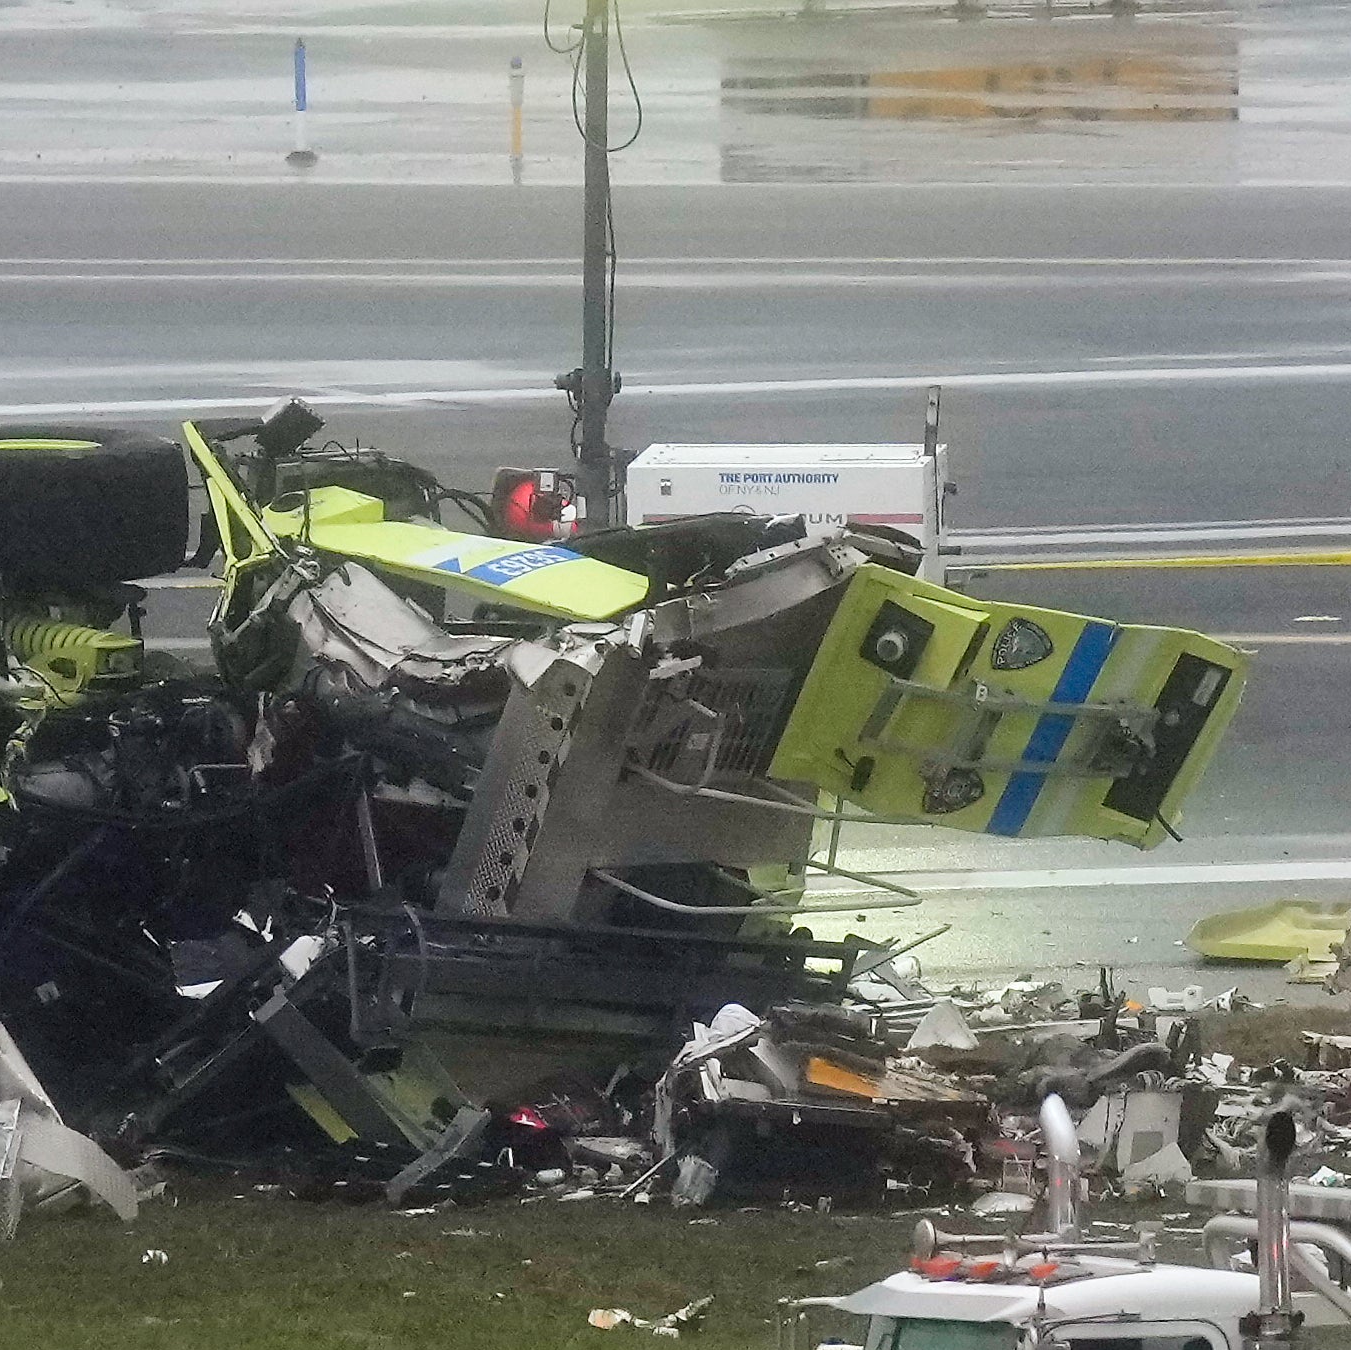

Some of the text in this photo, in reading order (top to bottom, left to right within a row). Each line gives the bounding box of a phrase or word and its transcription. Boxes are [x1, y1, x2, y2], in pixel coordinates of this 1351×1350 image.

[718, 472, 839, 484] THE PORT AUTHORITY
[996, 621, 1023, 666] POLICE
